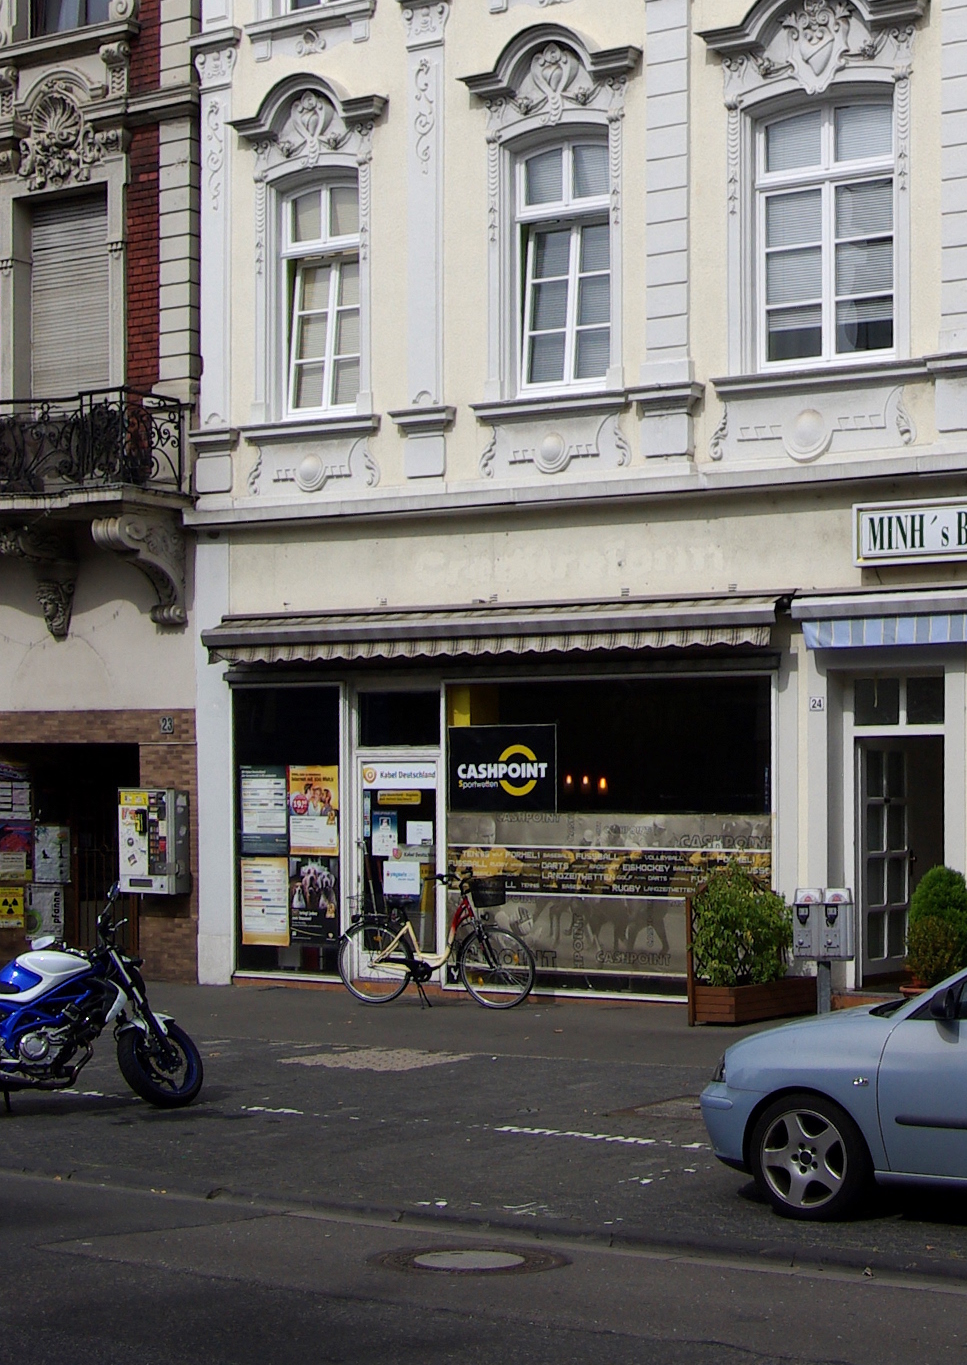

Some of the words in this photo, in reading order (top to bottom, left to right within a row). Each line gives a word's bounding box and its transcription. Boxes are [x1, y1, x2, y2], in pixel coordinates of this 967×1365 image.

[812, 698, 822, 709] 24
[161, 717, 173, 731] 23
[380, 770, 397, 778] Kabel
[398, 770, 436, 778] Deutschland
[457, 762, 548, 779] CASHPOINT
[458, 779, 499, 789] Sportwetten
[575, 852, 620, 861] FUSSBALL
[541, 861, 569, 869] DARTS
[622, 863, 671, 872] EISHOCKEY
[541, 871, 616, 881] LANGZEITWETTEN
[612, 884, 641, 893] RUGBY
[53, 891, 61, 924] pfanne
[596, 950, 672, 967] CASHPOINT
